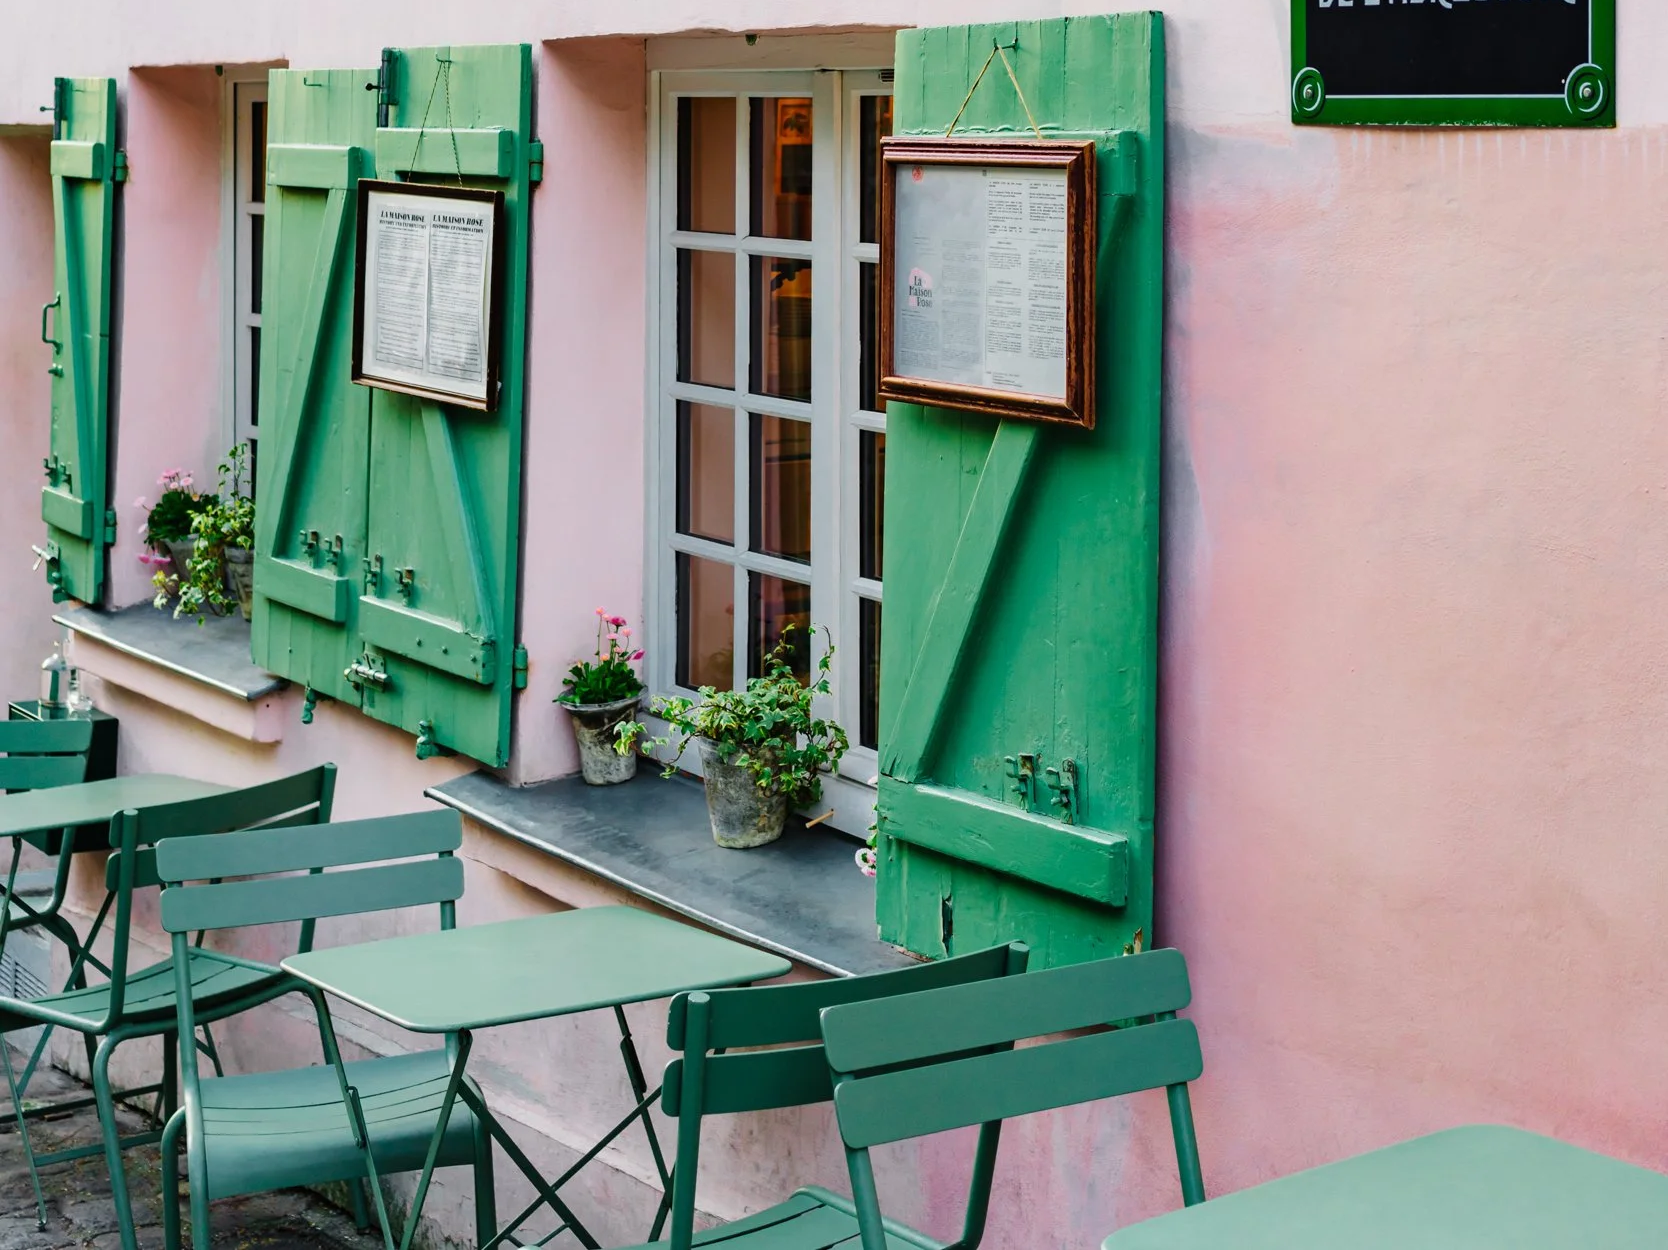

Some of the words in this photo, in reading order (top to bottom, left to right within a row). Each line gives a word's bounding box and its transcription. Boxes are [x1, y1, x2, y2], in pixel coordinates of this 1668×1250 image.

[389, 211, 411, 221] MAISON
[433, 214, 441, 222] LA
[442, 215, 466, 225] MAISON
[466, 218, 484, 227] ROSE
